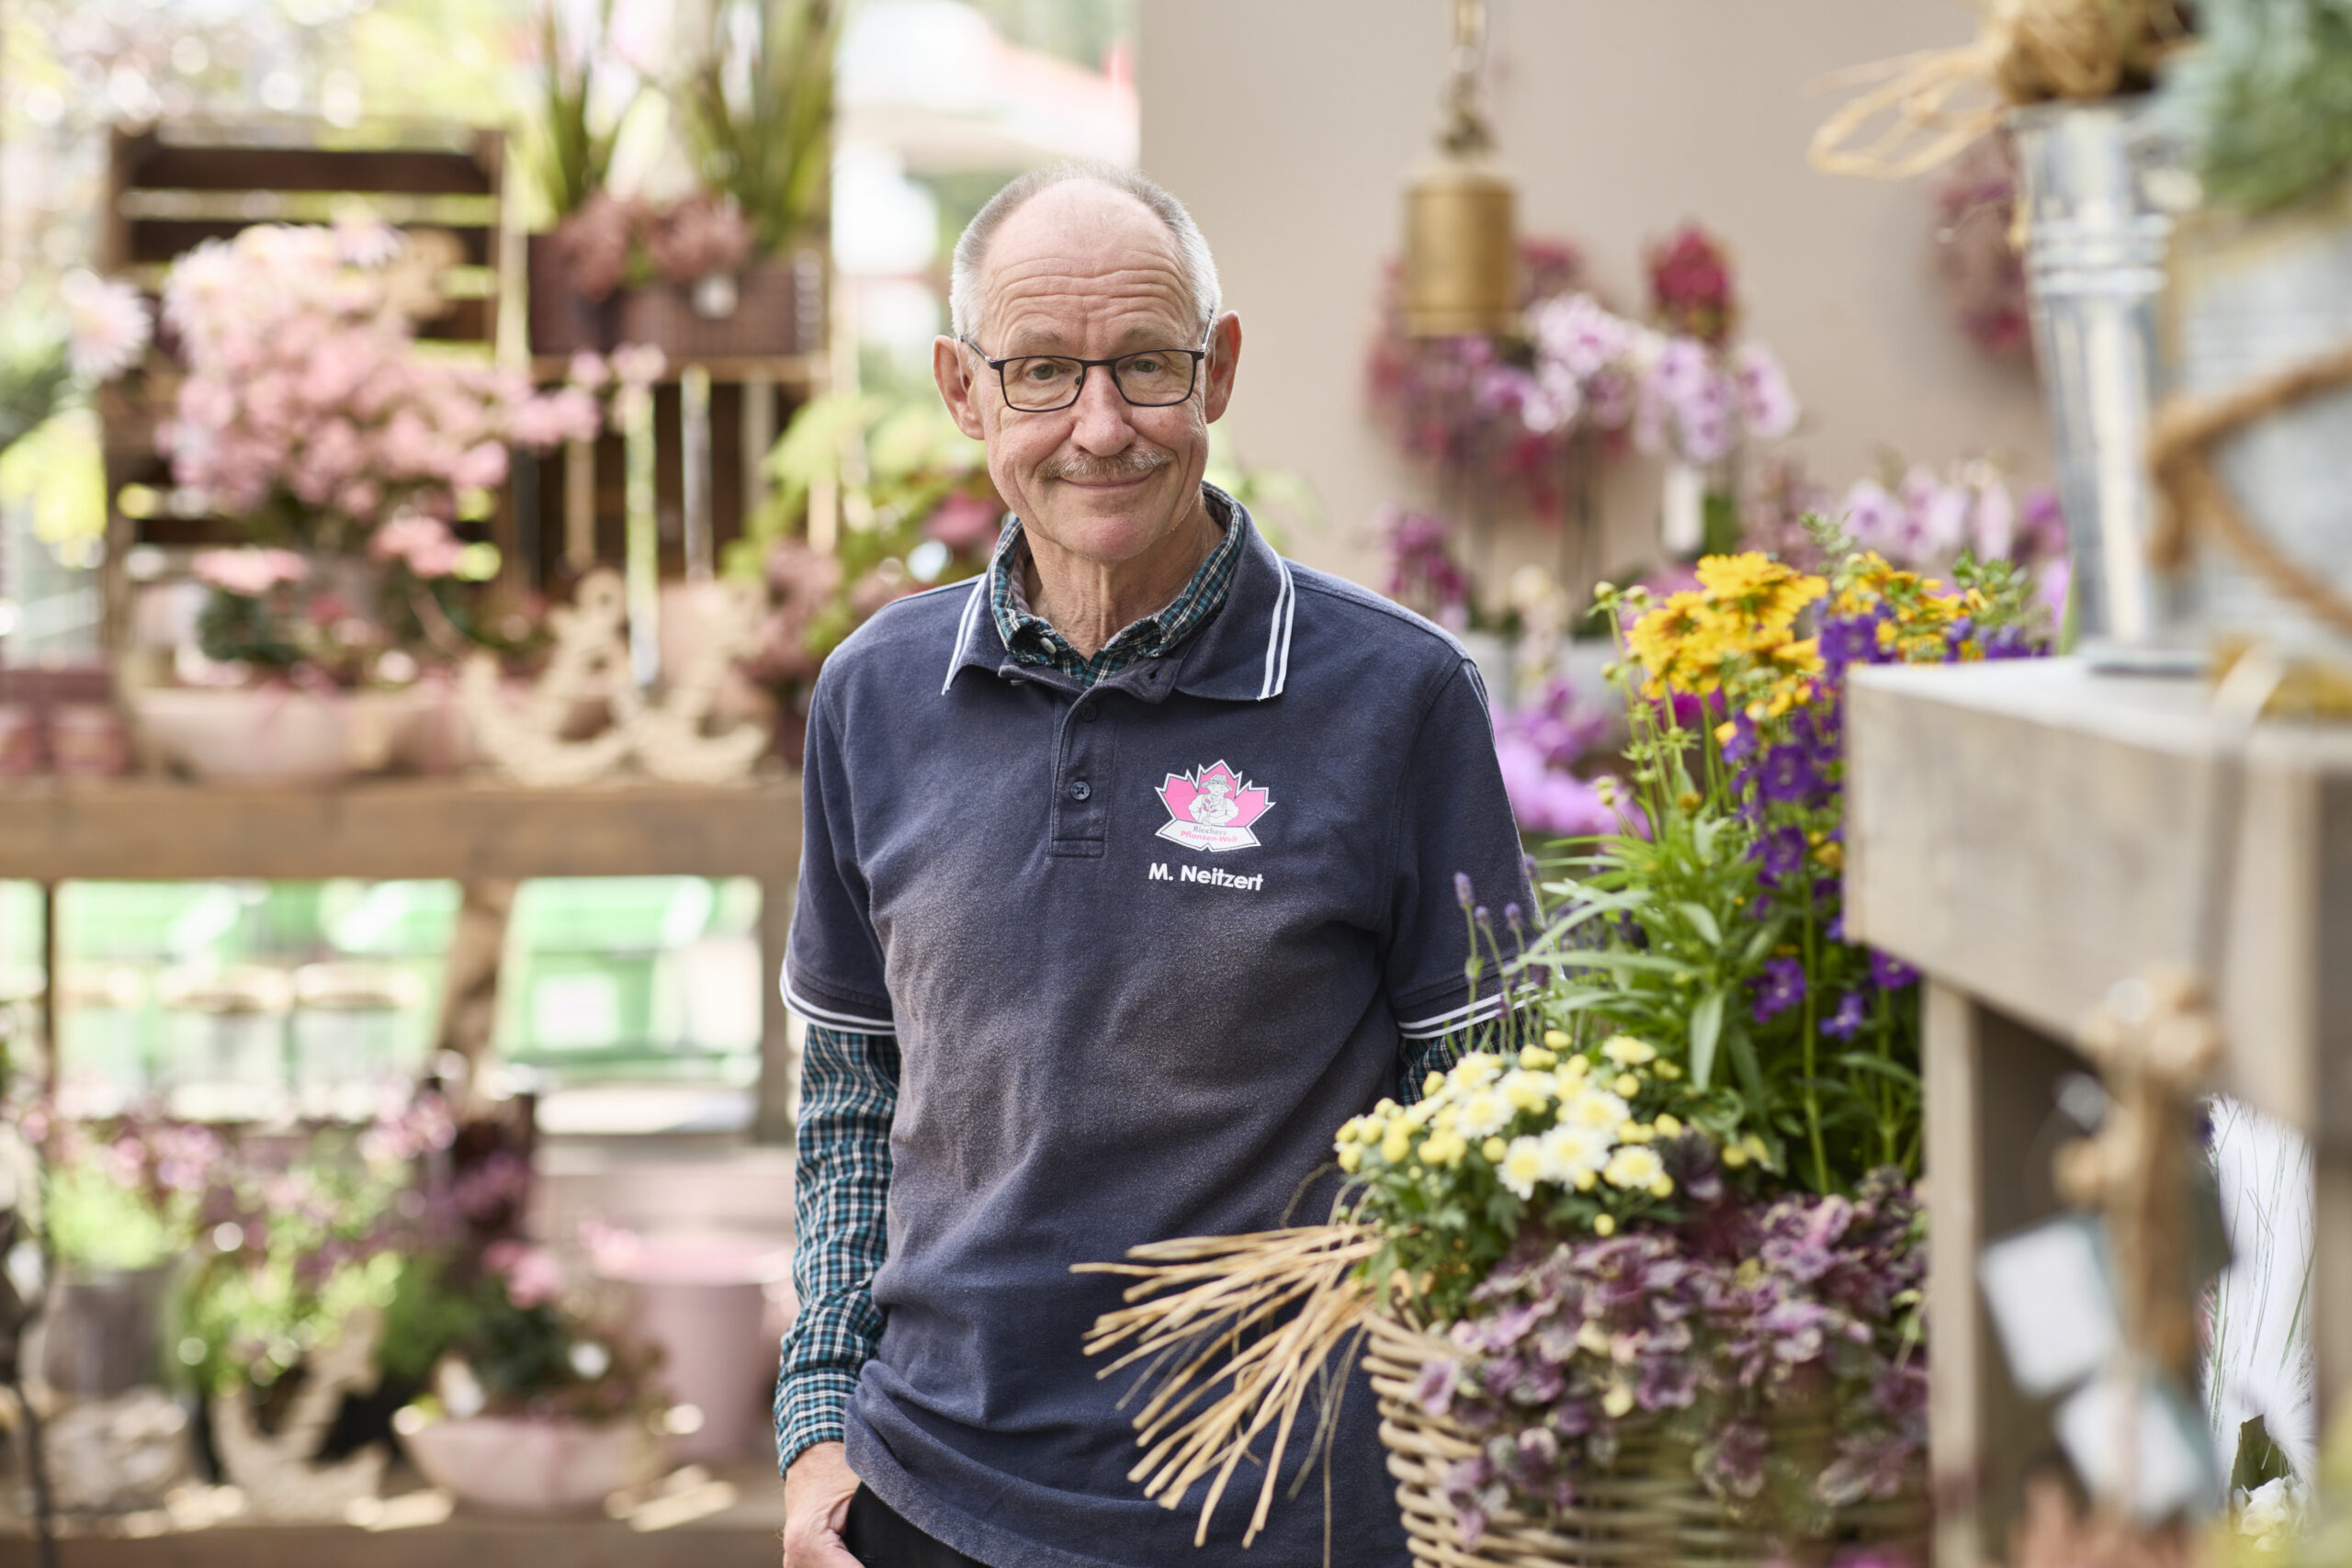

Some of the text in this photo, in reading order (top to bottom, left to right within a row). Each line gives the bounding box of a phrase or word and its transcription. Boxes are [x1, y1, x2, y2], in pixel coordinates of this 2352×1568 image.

[1181, 830, 1238, 842] Pflanzen-Welt
[1193, 825, 1227, 836] Riechers
[1148, 863, 1263, 891] M. Neitzert
